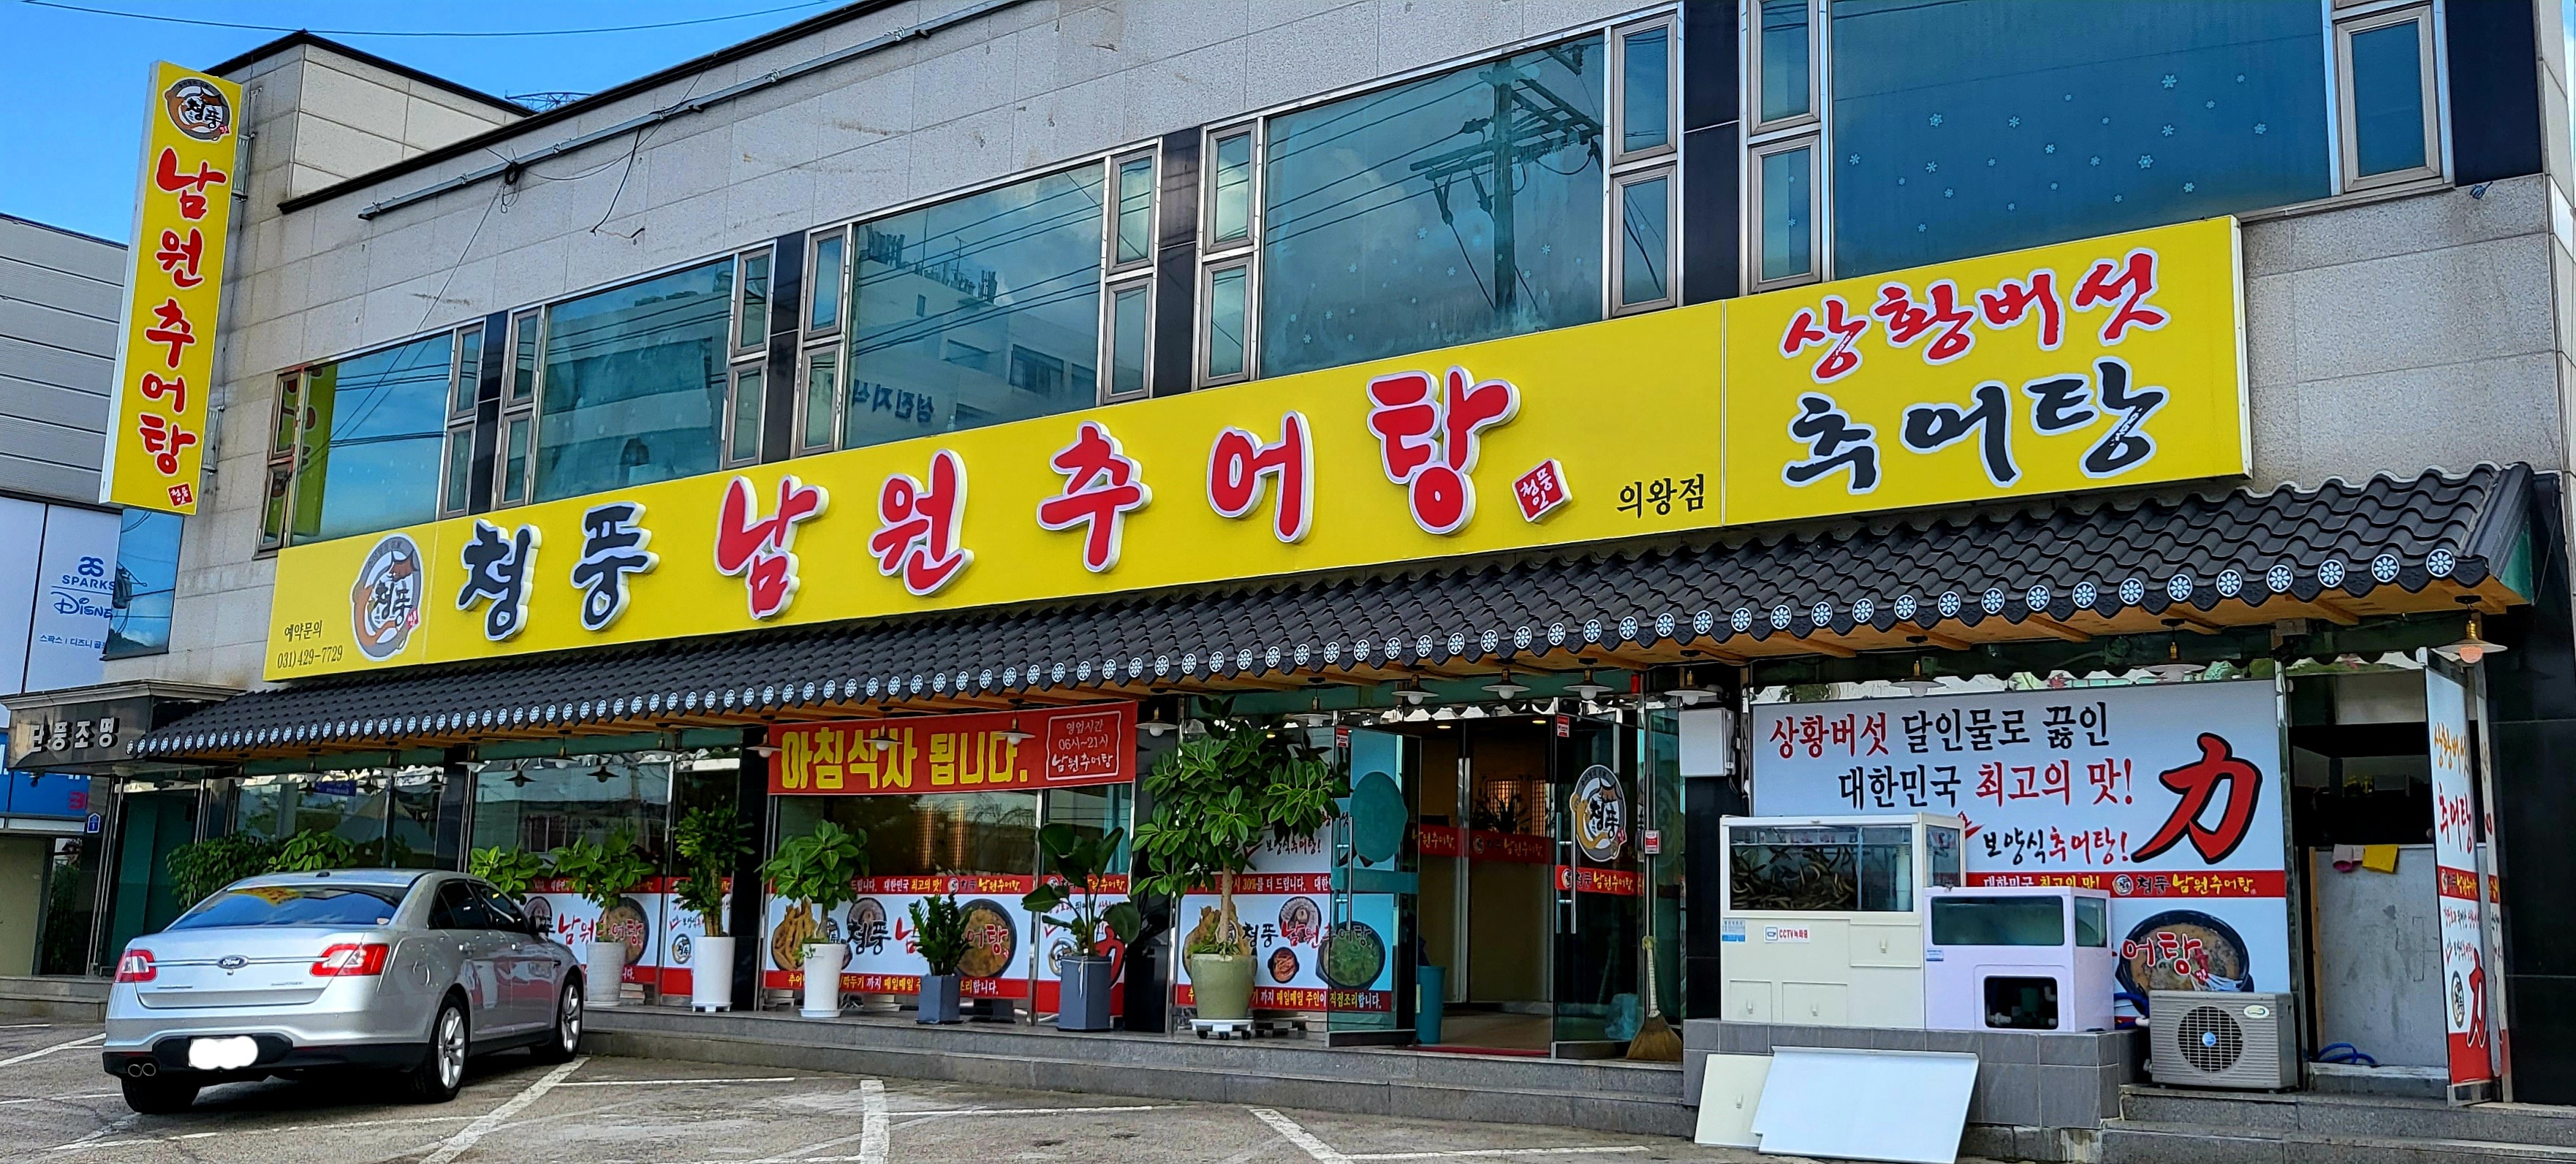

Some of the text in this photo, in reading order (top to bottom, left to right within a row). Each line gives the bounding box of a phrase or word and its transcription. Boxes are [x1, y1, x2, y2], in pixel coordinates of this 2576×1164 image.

[138, 147, 227, 475] 남원추어탕
[1781, 252, 2166, 378] 상황버섯
[1785, 362, 2164, 490] 추어탕
[457, 369, 1515, 640] 청풍 남원추어탕
[1616, 473, 1705, 519] 의왕점
[62, 574, 115, 590] SPARKS
[70, 638, 93, 648] 디즈니
[284, 620, 322, 642] 예약문의
[277, 645, 343, 669] 031)429-7729
[1066, 718, 1104, 734] 영업시간
[1769, 701, 2110, 758] 상황버섯 달인물로 끓인
[1058, 733, 1109, 750] 06시~21시
[781, 727, 1028, 789] 아침식사 됩니다.
[1051, 753, 1113, 772] 남원추어탕
[1838, 758, 2132, 810] 대한민국 최고의 맛!
[1589, 797, 1620, 840] 청풍
[2439, 781, 2472, 854] 추어탕
[1982, 826, 2129, 865] 보양식추어탕!
[884, 878, 909, 892] 대한민국
[911, 878, 931, 892] 최고의
[978, 878, 1020, 892] 남원추어탕
[1267, 878, 1273, 891] 더
[1276, 876, 1307, 891] 드립니다.
[1594, 870, 1634, 892] 남원추어탕
[2172, 873, 2254, 894] 남원추어탕
[846, 918, 892, 955] 청풍
[1243, 920, 1372, 949] 청풍 남원추어탕
[222, 957, 240, 965] Ford
[866, 975, 882, 990] 까지
[884, 977, 913, 992] 매일매일
[1277, 989, 1303, 1006] 매일매일
[1306, 989, 1327, 1007] 주인이
[1330, 992, 1382, 1009] 직접조리합니다.
